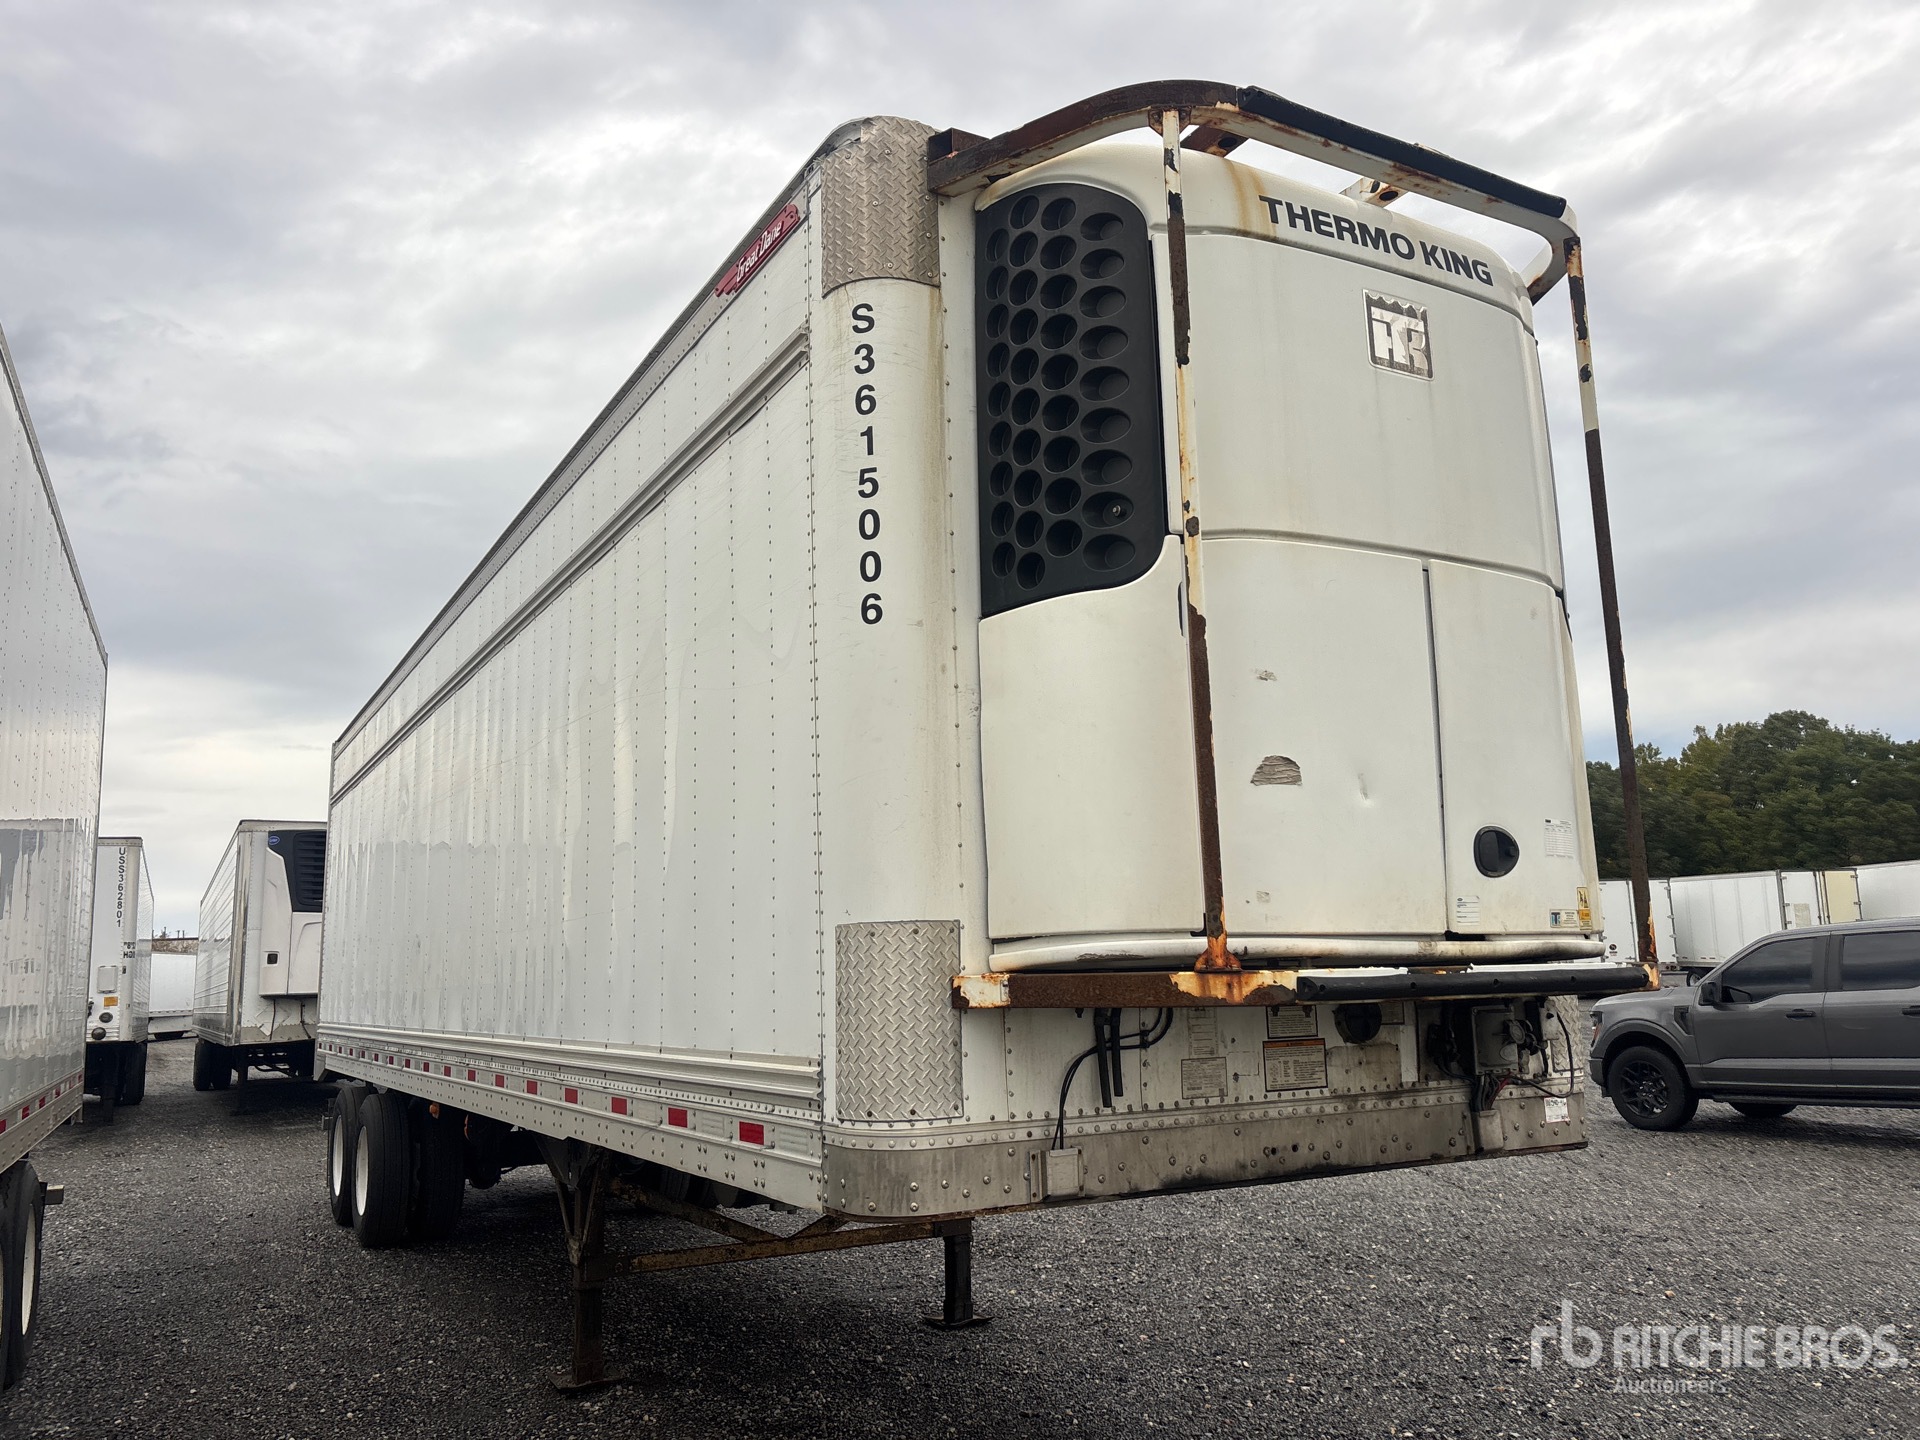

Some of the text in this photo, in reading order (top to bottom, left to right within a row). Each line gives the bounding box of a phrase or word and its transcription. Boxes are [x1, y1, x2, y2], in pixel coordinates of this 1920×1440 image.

[736, 221, 783, 283] Great Dane
[1258, 195, 1494, 287] THERMO KING
[851, 303, 883, 625] S3615006
[116, 847, 126, 928] USS362801
